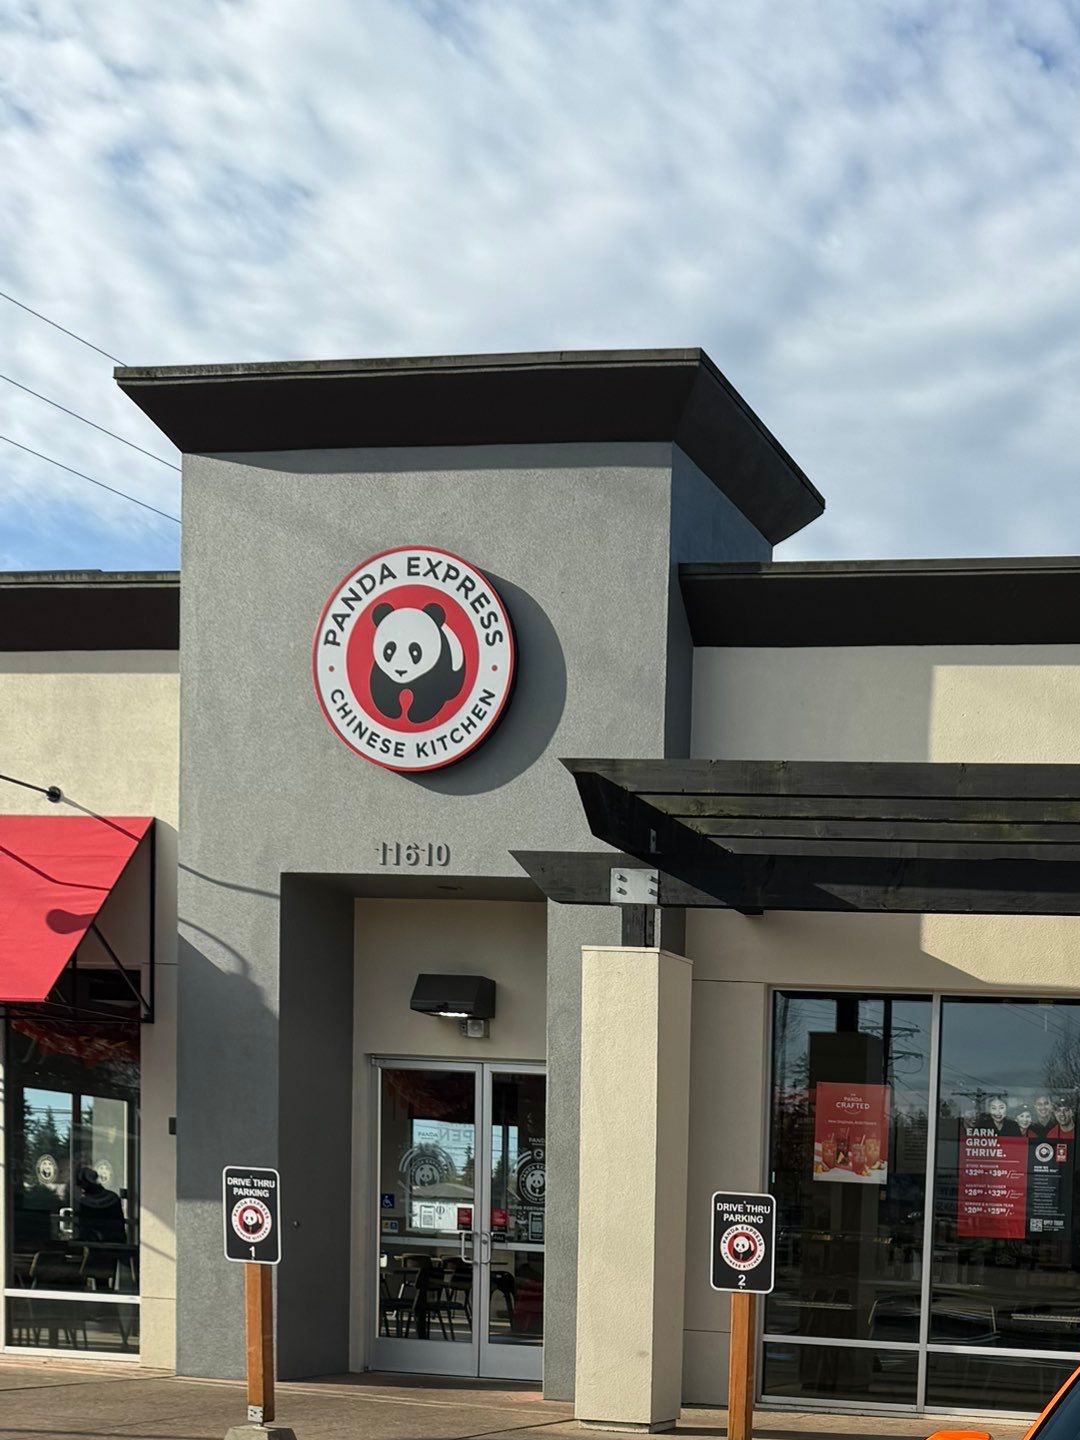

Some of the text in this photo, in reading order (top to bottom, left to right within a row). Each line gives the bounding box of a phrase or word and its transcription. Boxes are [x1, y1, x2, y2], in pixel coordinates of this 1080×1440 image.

[323, 556, 503, 647] PANDA EXPRESS
[331, 688, 496, 758] CHINESE KITCHEN
[374, 841, 451, 867] 11610
[835, 1101, 871, 1110] CRAFTED
[966, 1128, 998, 1137] EARN.
[965, 1138, 1001, 1147] GROW.
[965, 1148, 1006, 1157] THRIVE.
[227, 1177, 275, 1188] DRIVE THRU
[233, 1187, 269, 1197] PARKING
[717, 1202, 771, 1214] DRIVE THRU
[723, 1213, 764, 1224] PARKING
[249, 1245, 255, 1258] 1
[737, 1274, 746, 1286] 2
